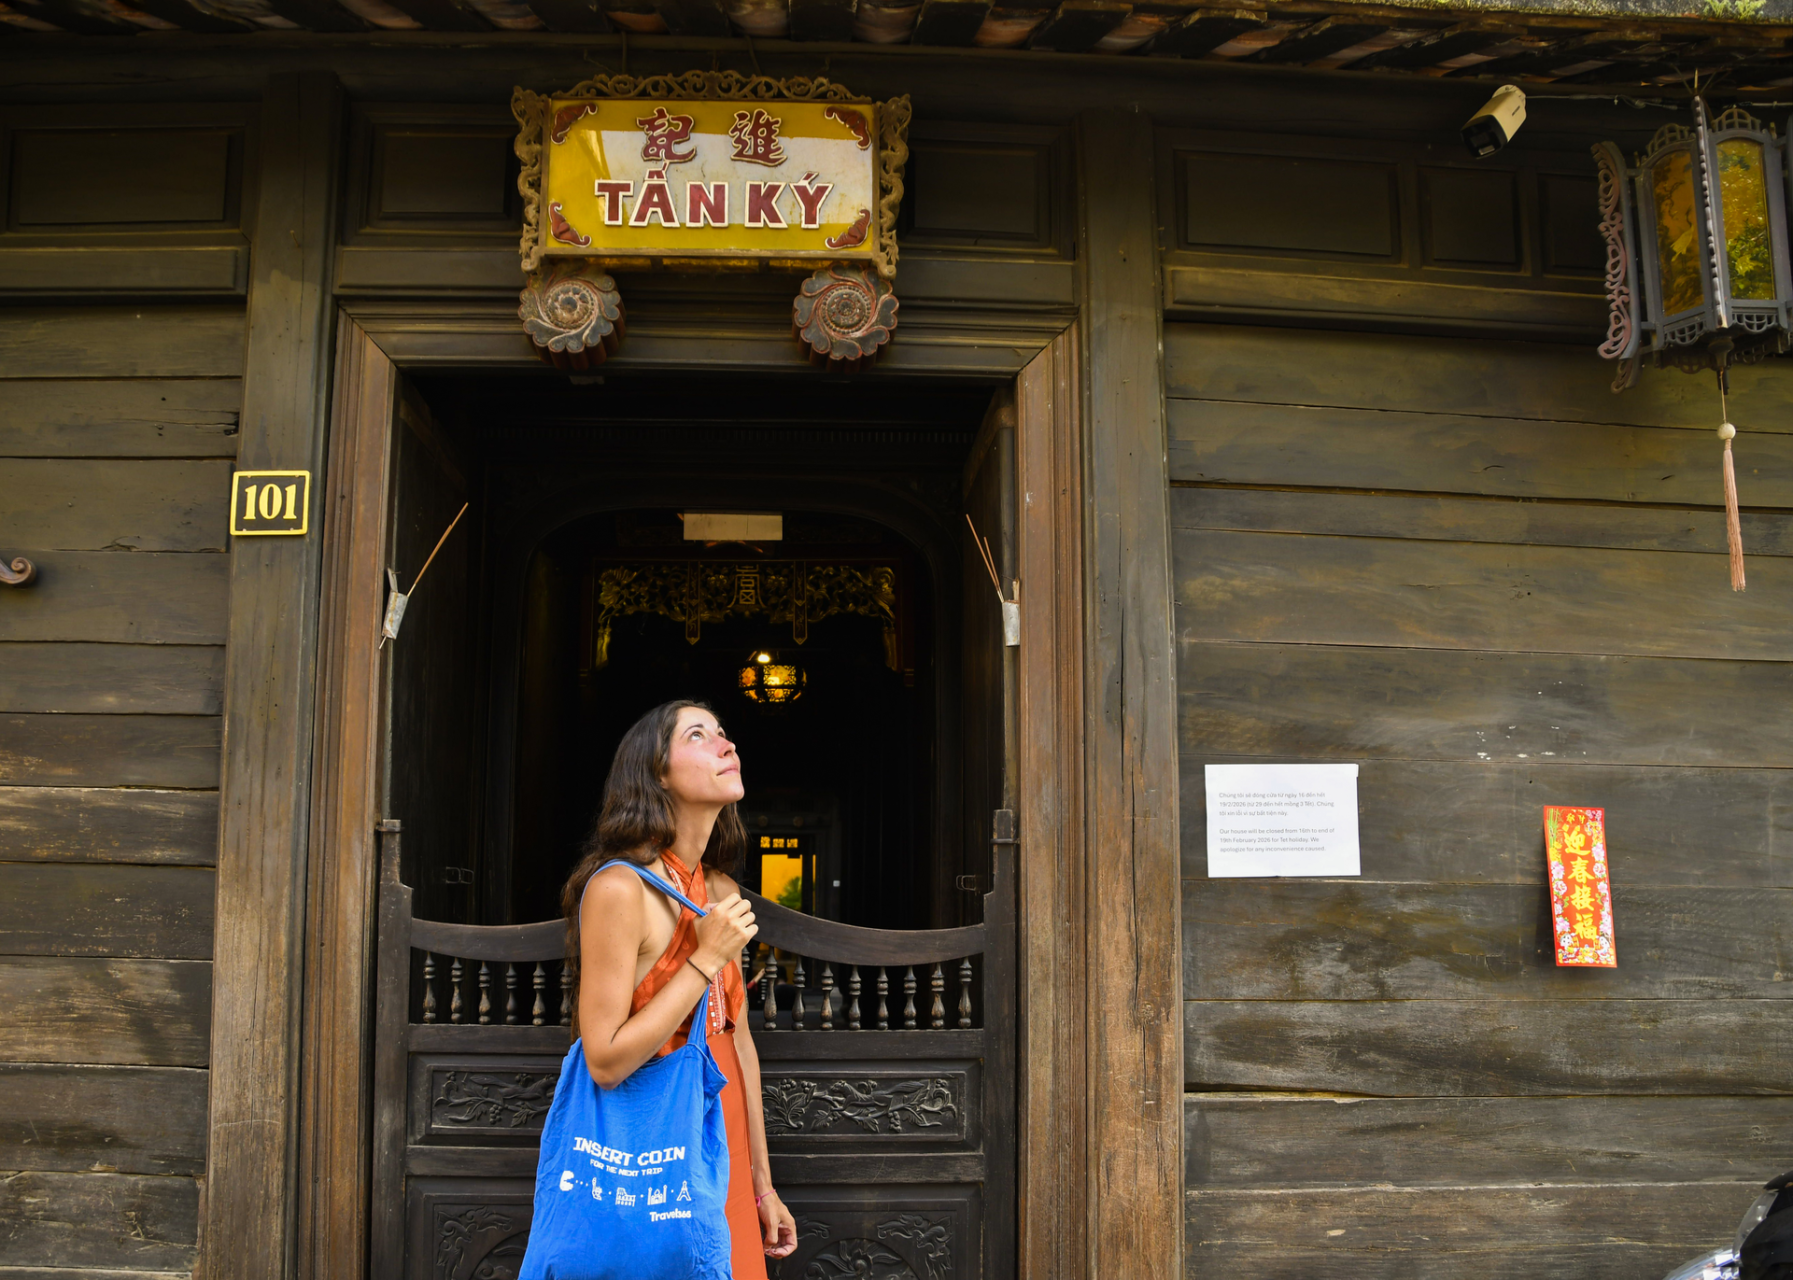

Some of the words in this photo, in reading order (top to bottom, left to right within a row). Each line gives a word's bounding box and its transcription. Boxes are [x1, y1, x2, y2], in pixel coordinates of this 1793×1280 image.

[594, 160, 729, 228] TẤN
[744, 171, 834, 229] KÝ
[243, 483, 297, 520] 101
[1562, 824, 1598, 940] 迎春接福
[573, 1136, 634, 1166] INSERT
[637, 1146, 686, 1166] COIN
[590, 1158, 604, 1170] FOR
[618, 1168, 640, 1177] NEXT
[641, 1167, 663, 1176] TRIP
